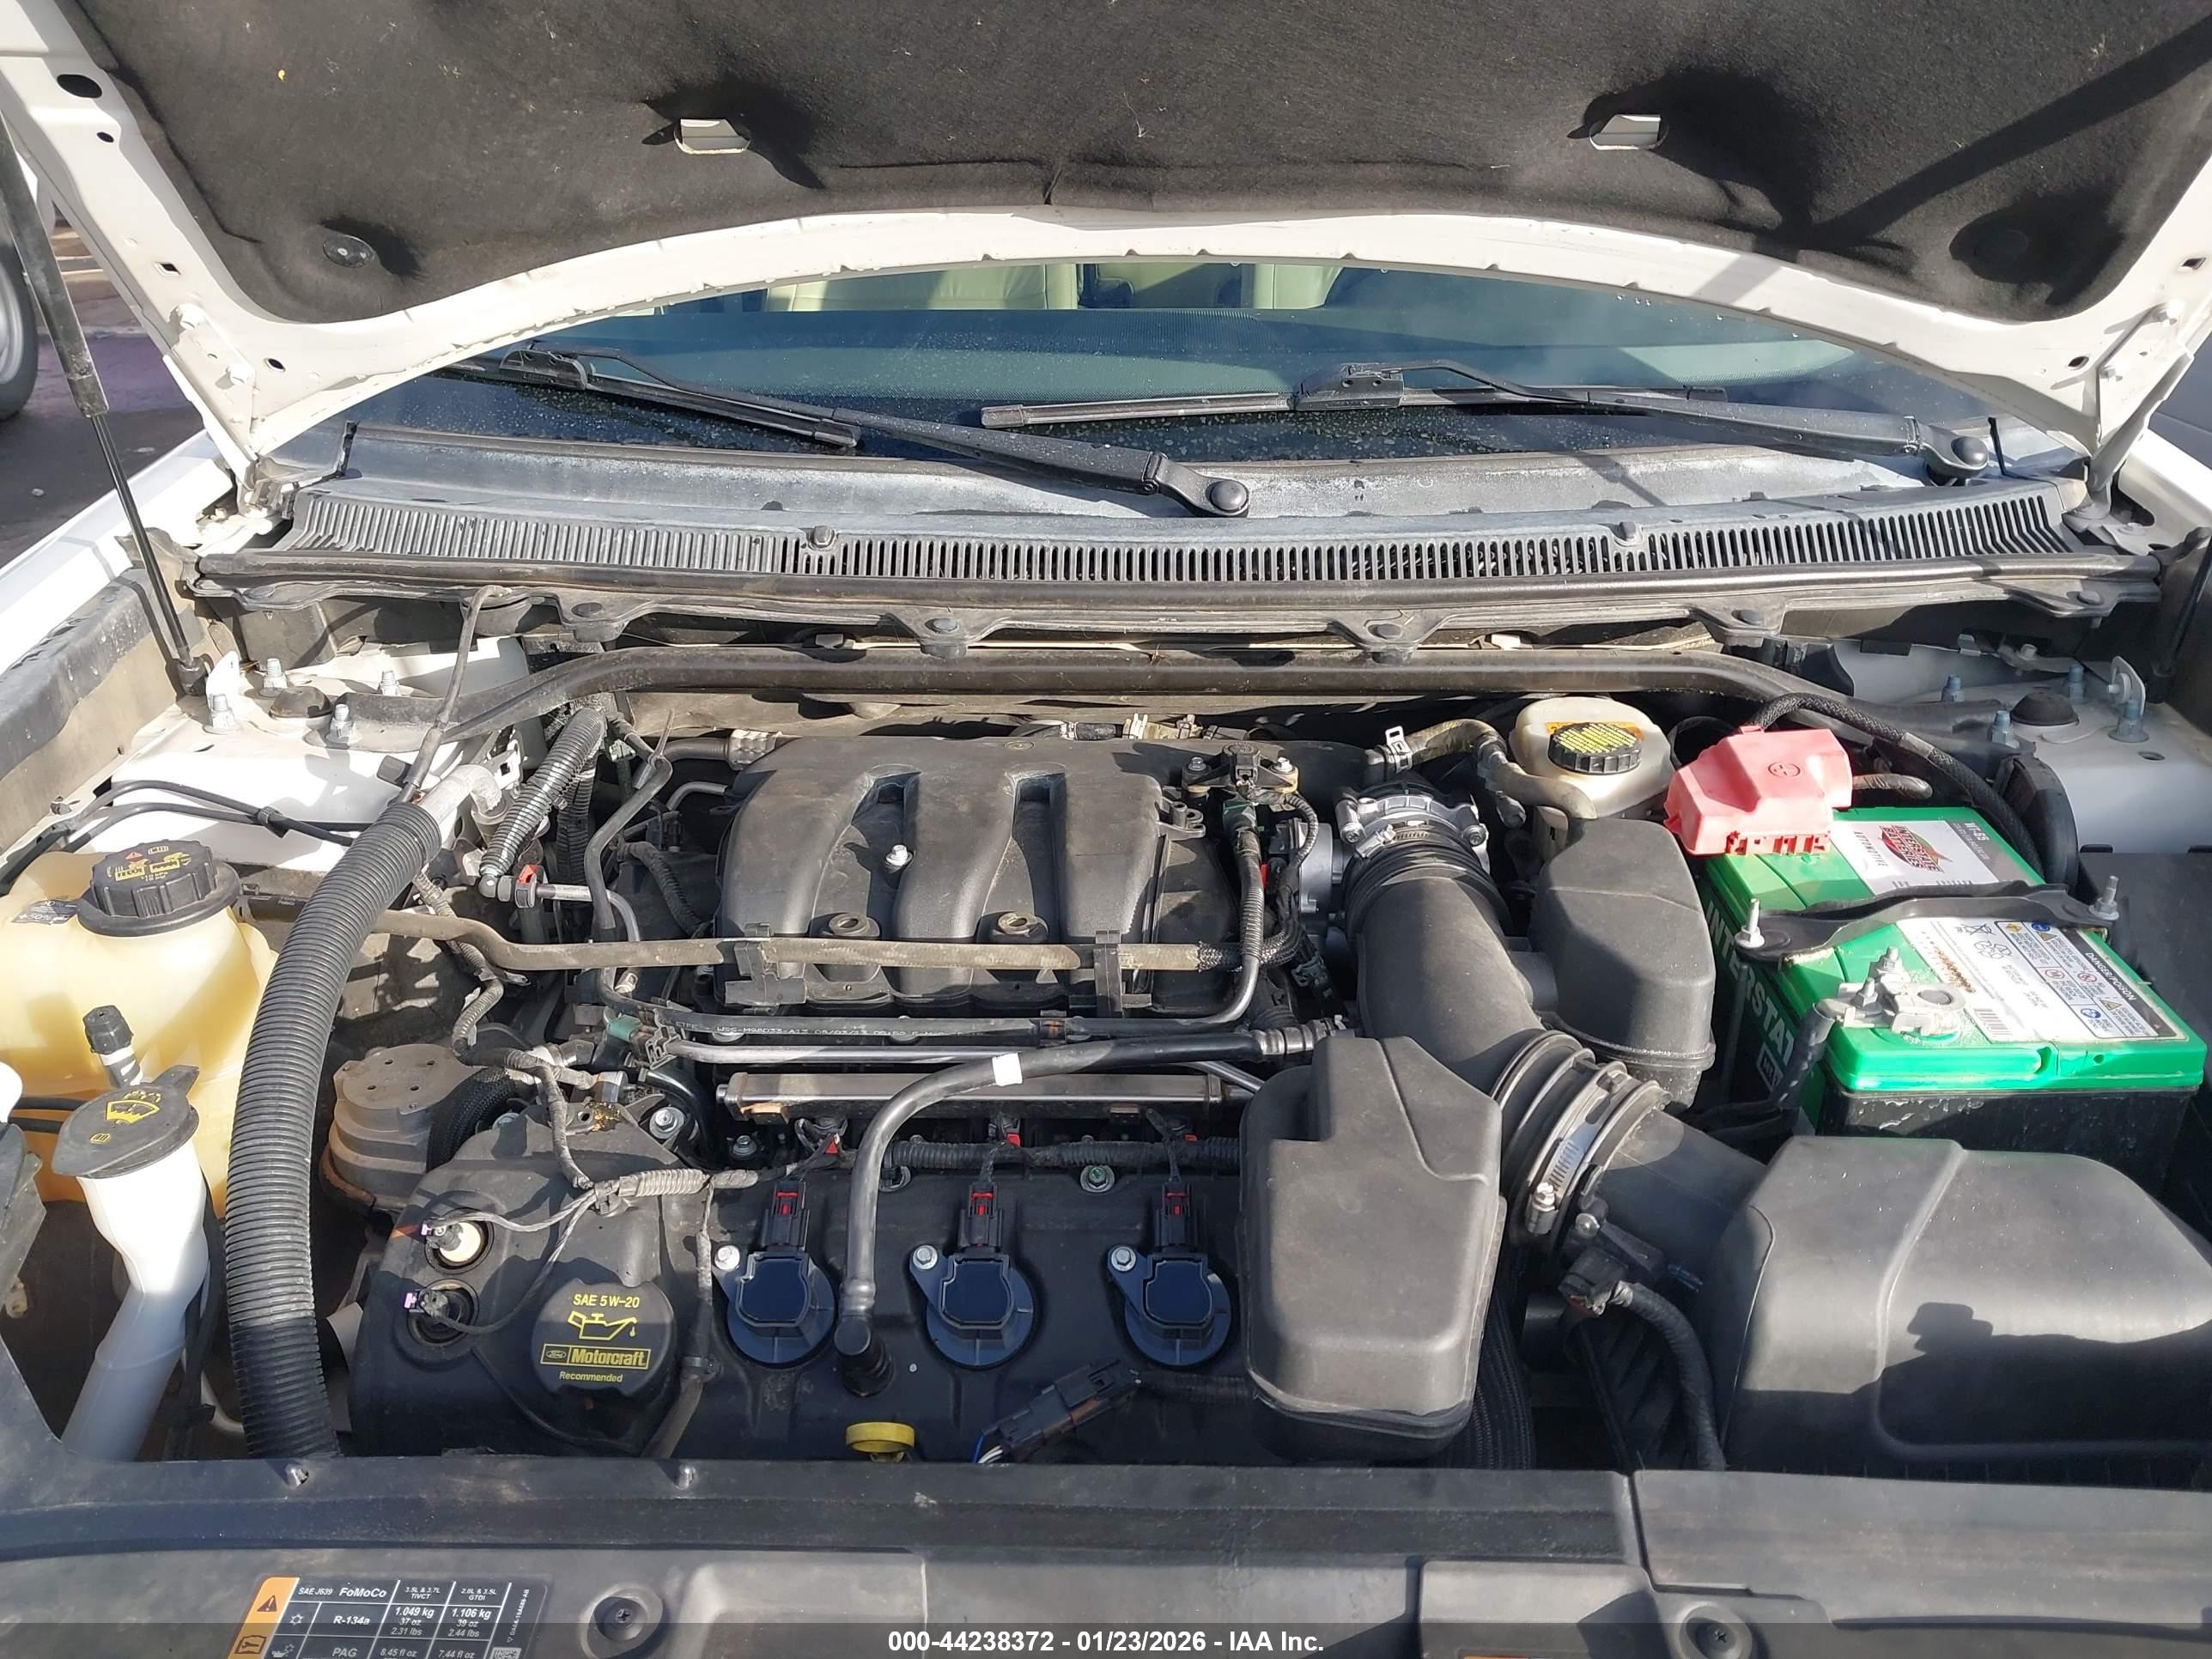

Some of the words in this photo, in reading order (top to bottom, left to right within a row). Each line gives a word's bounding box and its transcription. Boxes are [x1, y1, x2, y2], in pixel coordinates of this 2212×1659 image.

[1854, 831, 1889, 867] AUTOMOTIVE
[1881, 825, 1924, 869] BATTERIES
[1893, 825, 1944, 872] INTERSTATE
[1705, 901, 1795, 1066] INTERSTAT
[573, 1294, 597, 1306] SAE
[599, 1295, 640, 1308] 5W-20
[571, 1348, 646, 1366] Motorcraft
[559, 1371, 623, 1382] Recommended
[339, 1588, 387, 1597] FoMoCo
[395, 1607, 420, 1616] 1.049
[422, 1608, 434, 1619] kg
[452, 1608, 477, 1618] 1.106
[478, 1609, 492, 1620] kg
[333, 1616, 370, 1626] R-134a
[332, 1648, 358, 1657] PAG
[380, 1648, 398, 1656] 8.45
[439, 1650, 457, 1658] 7.44
